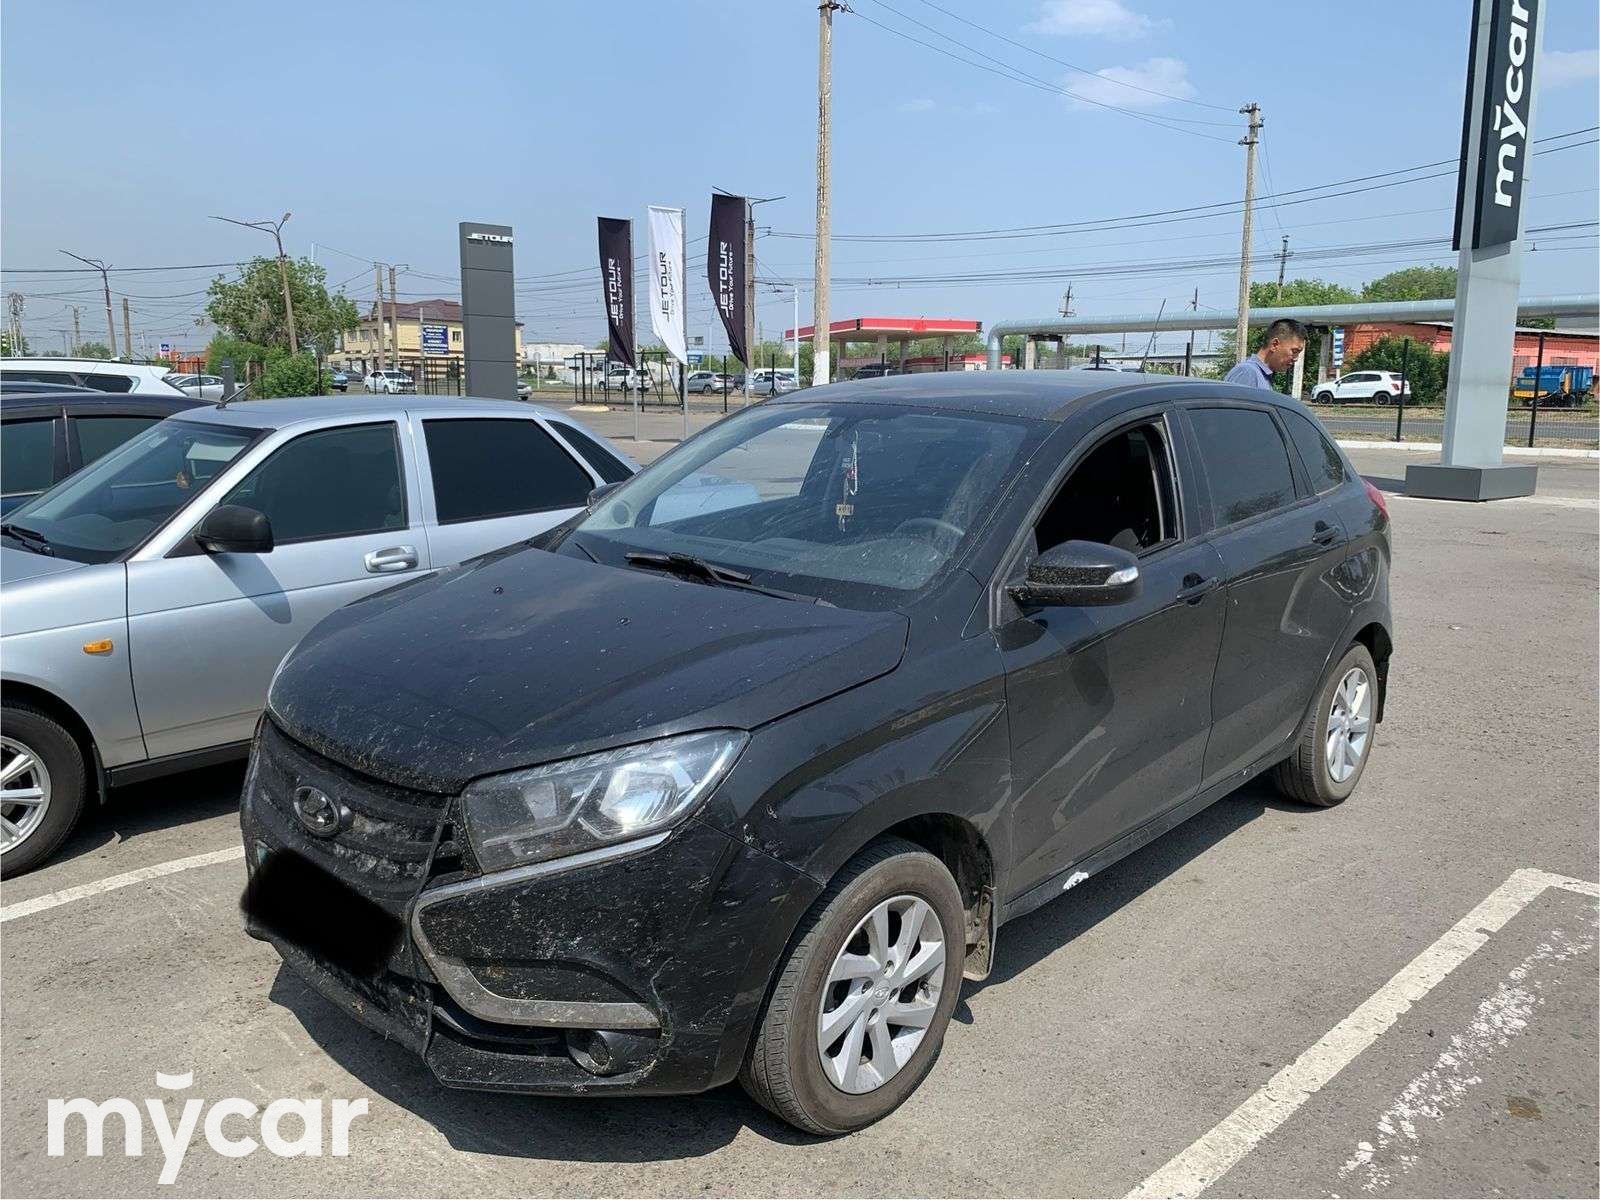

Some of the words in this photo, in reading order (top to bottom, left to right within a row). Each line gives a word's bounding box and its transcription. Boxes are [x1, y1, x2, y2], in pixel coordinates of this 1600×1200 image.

[466, 232, 514, 243] JETOUR
[608, 258, 619, 327] JETOUR
[659, 251, 670, 323] JETOUR
[719, 241, 730, 318] JETOUR
